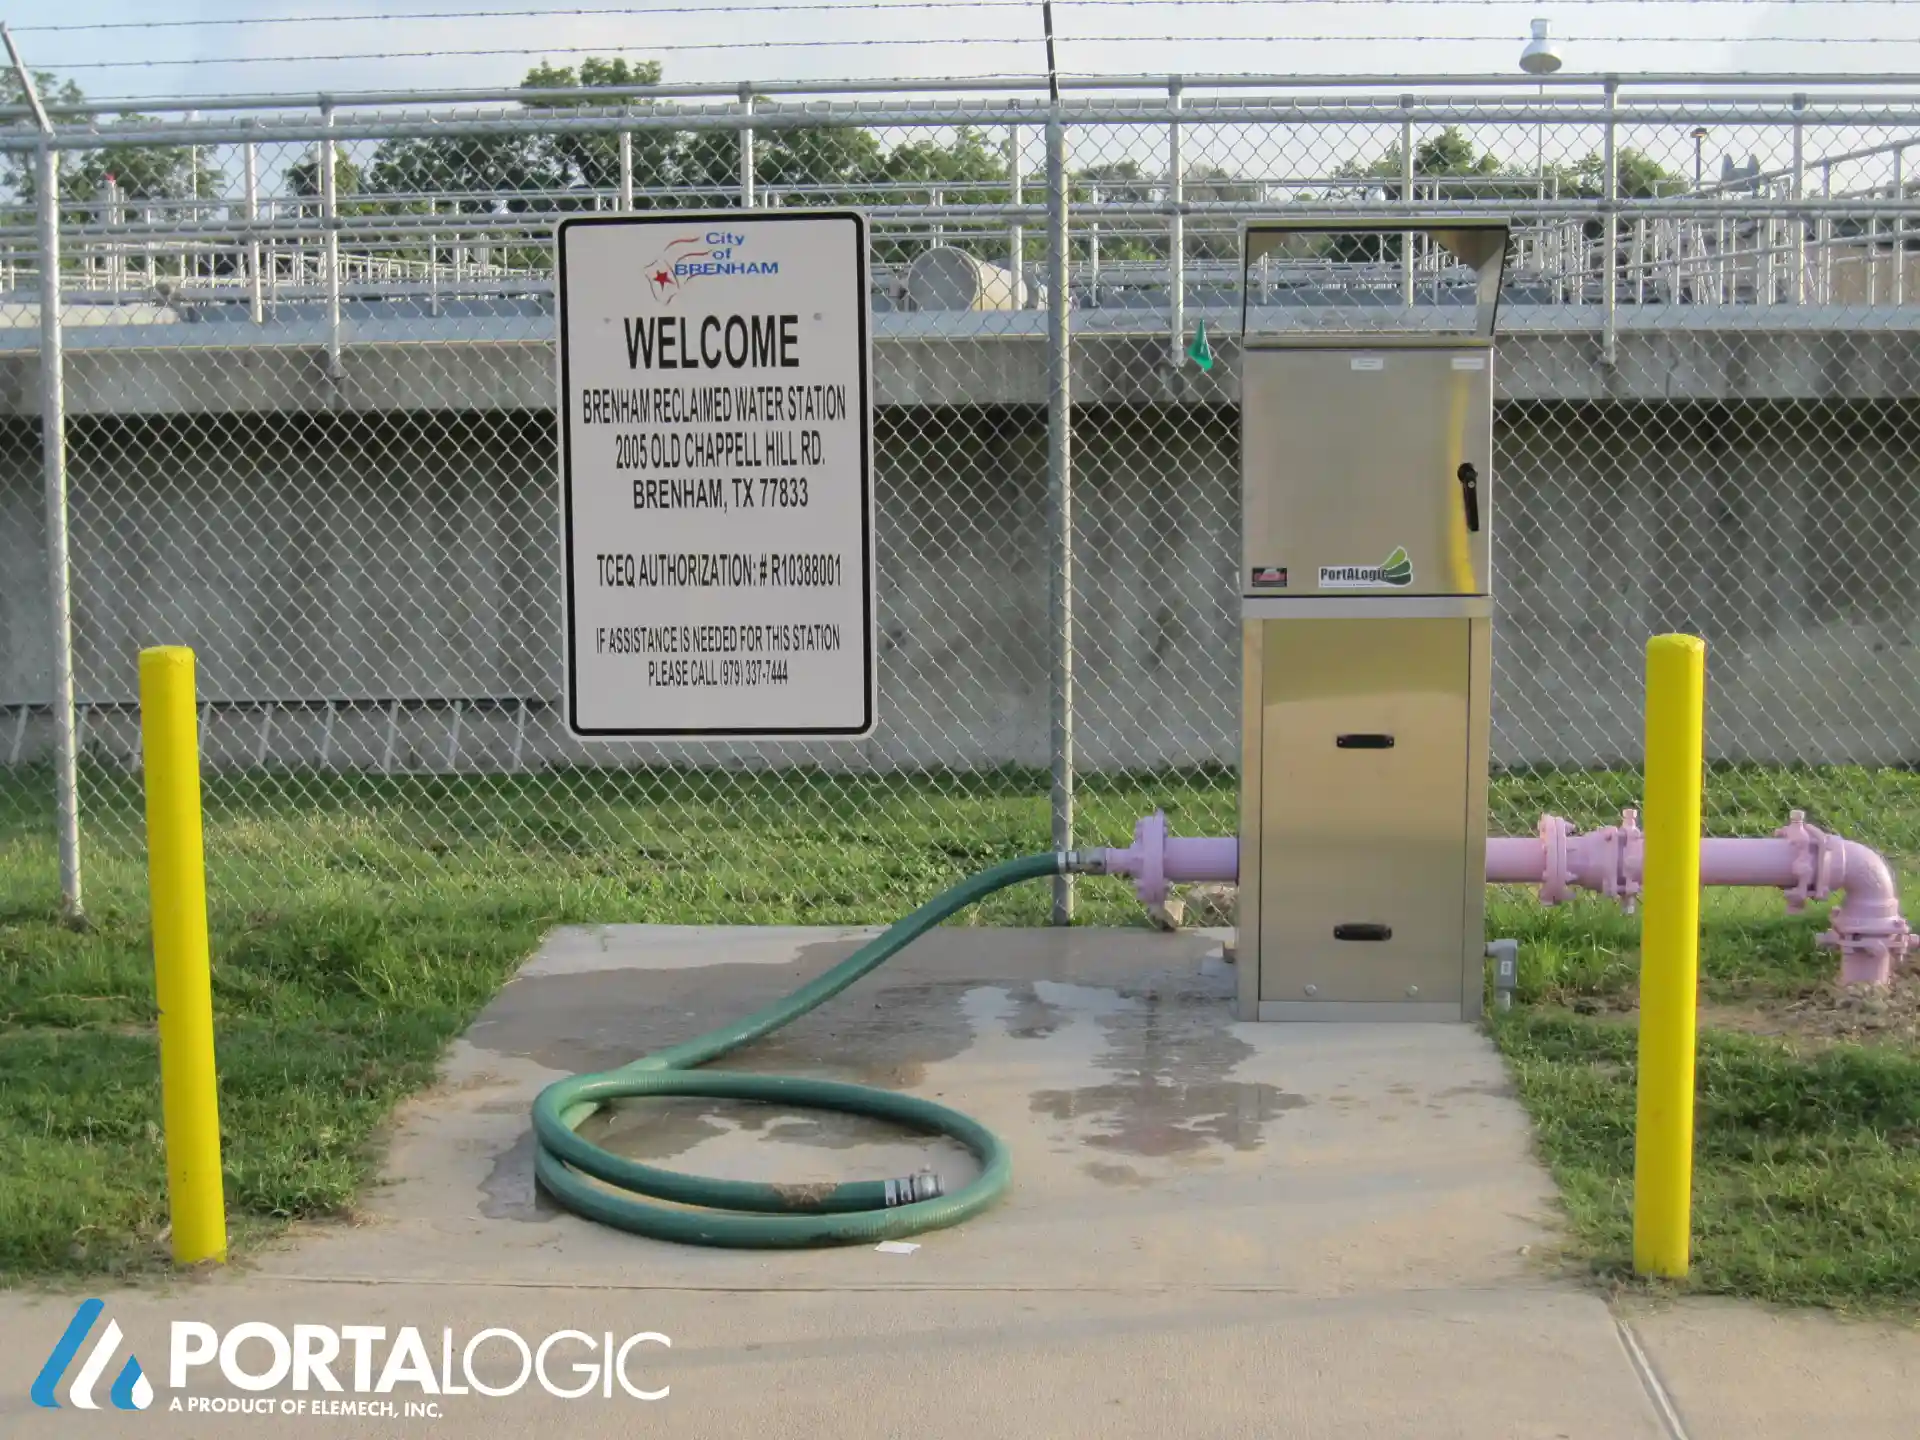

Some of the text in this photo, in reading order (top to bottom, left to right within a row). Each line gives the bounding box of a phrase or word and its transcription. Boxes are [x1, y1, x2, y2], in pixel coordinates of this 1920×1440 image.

[705, 232, 745, 246] City
[712, 248, 732, 260] of
[675, 262, 779, 276] BRENHAM
[624, 314, 800, 370] WELCOME
[583, 384, 846, 424] BRENHAM RECLAIMED WATER STATION
[616, 430, 825, 470] 2005 OLD CHAPPELL HILL RD.
[633, 477, 809, 514] BRENHAM, TX 77833
[597, 553, 842, 588] TCEQ AUTHORIZATION: # R10388001
[596, 623, 840, 654] IF ASSISTANCE IS NEEDED FOR THIS STATION
[648, 658, 788, 687] PLEASE CALL (979) 337-7444
